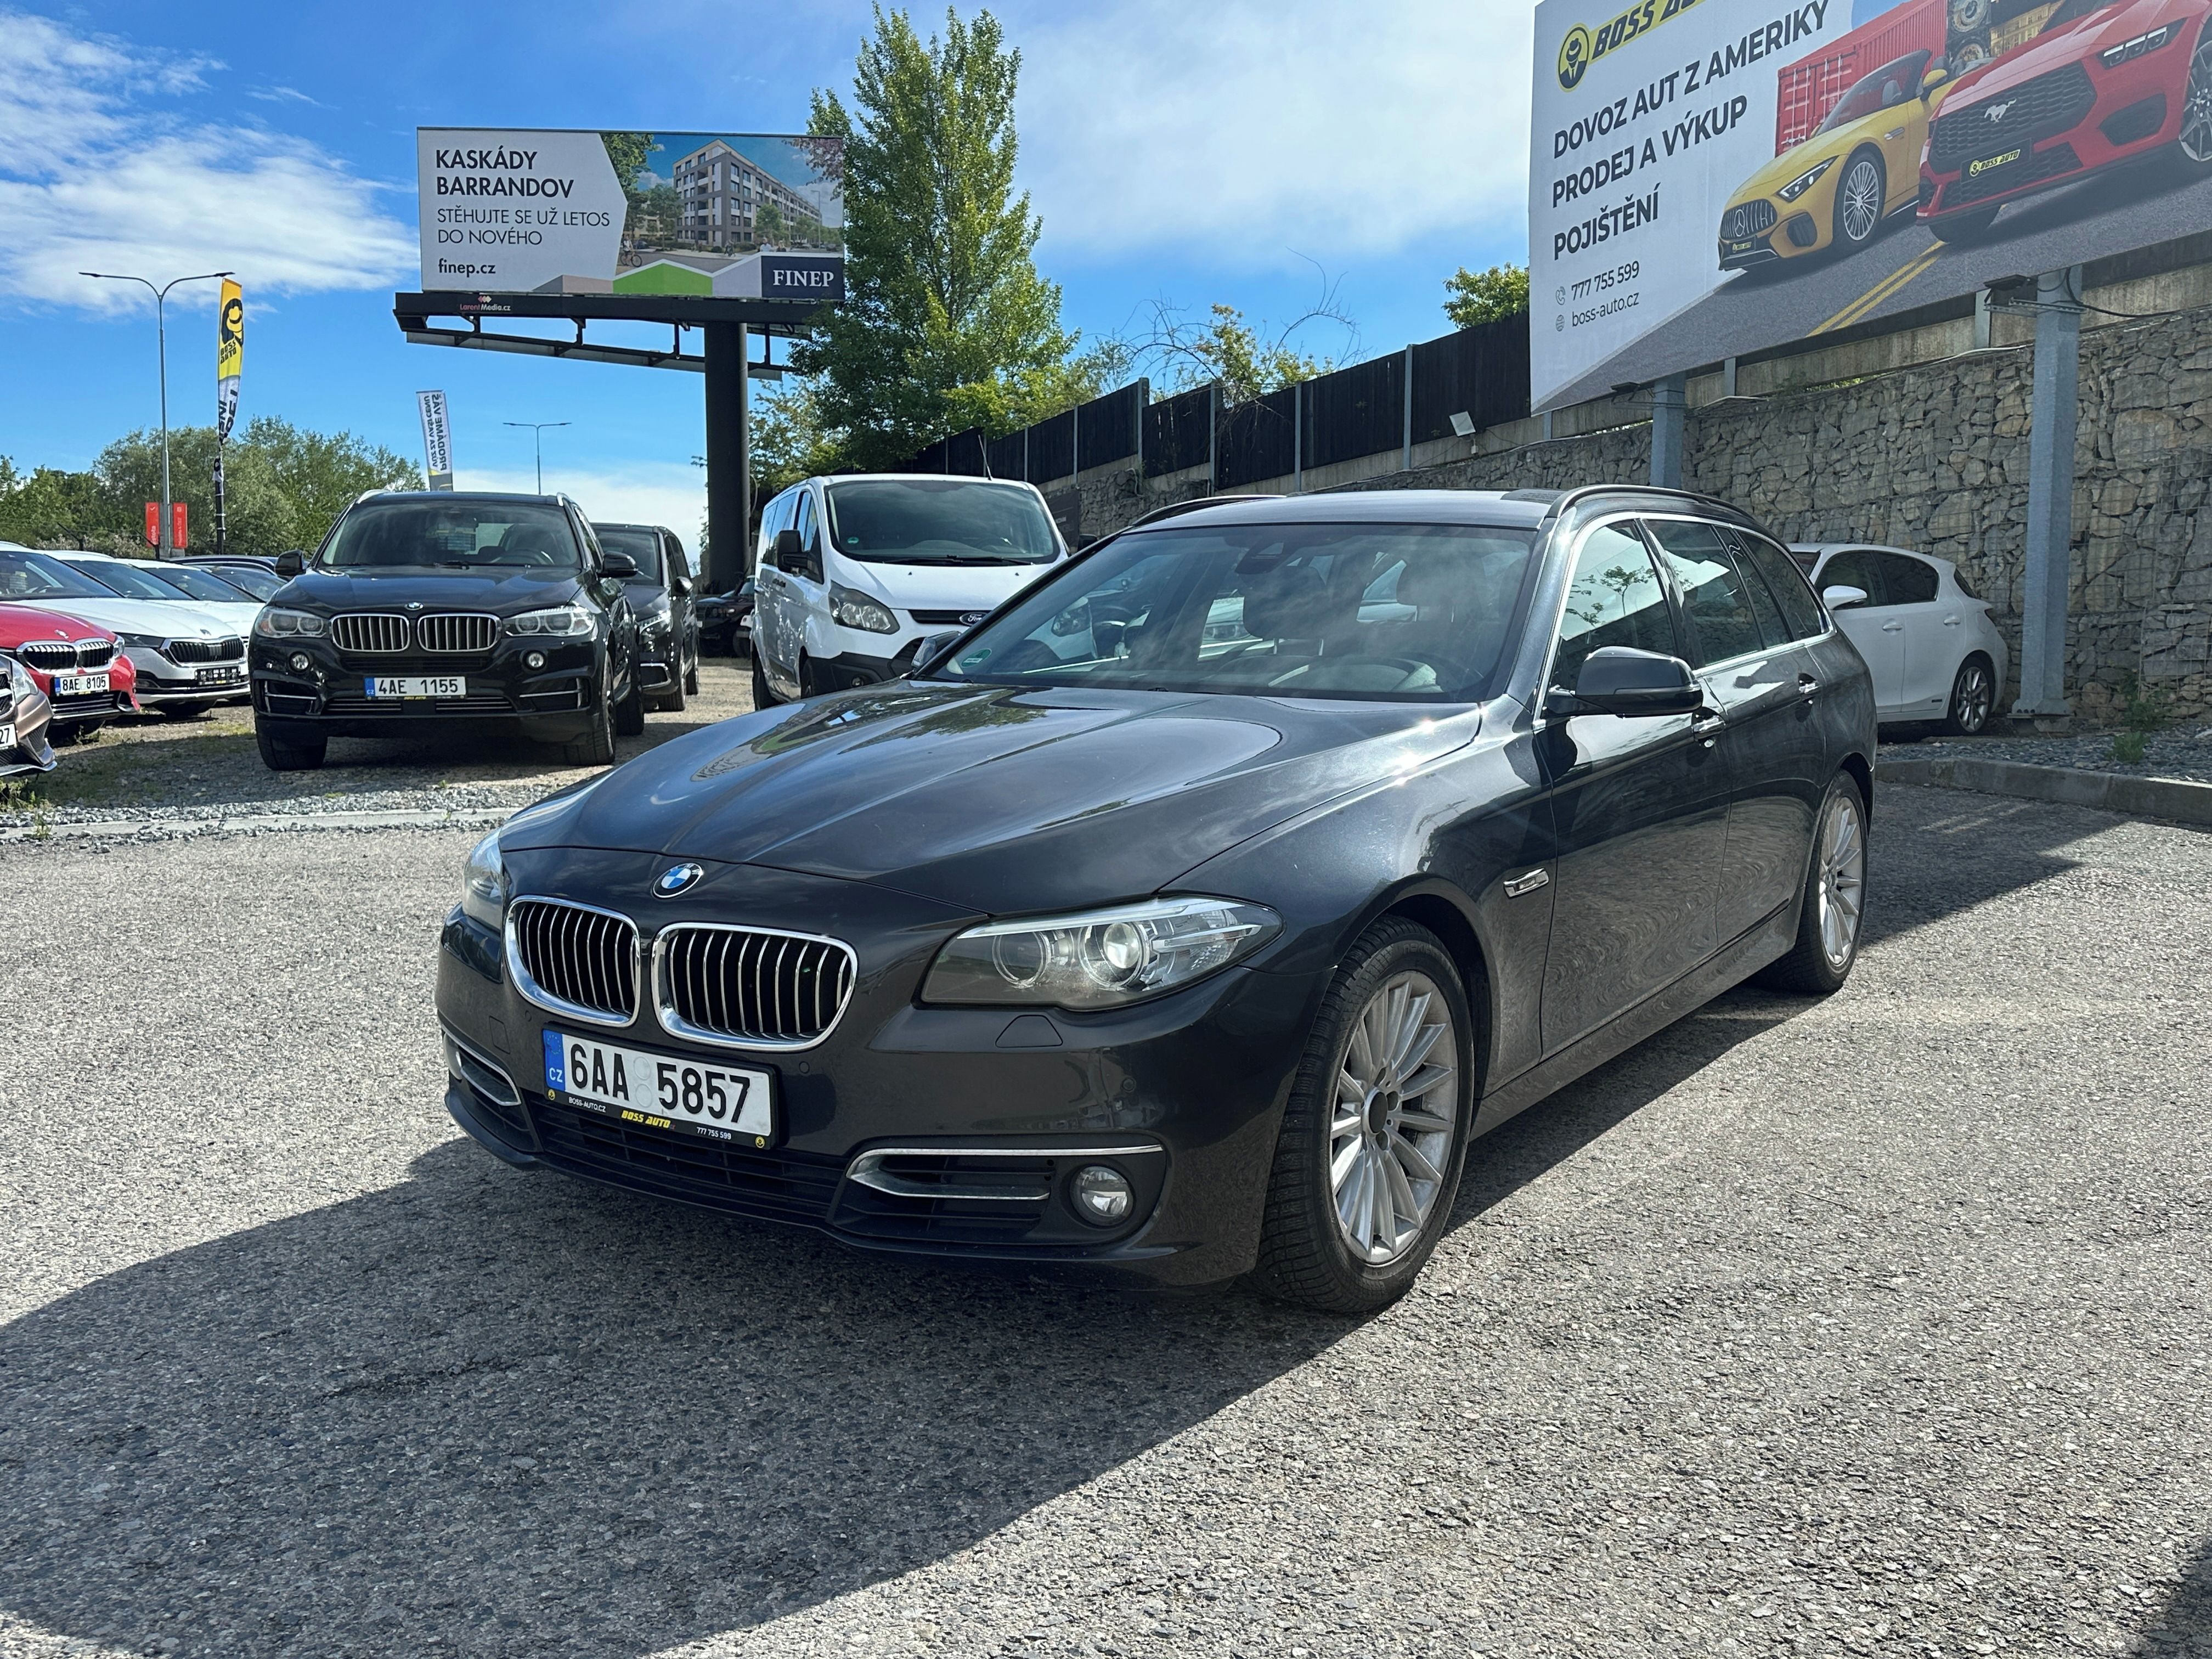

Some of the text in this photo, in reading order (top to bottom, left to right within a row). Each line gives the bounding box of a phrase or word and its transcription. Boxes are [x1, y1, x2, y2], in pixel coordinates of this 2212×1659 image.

[1592, 0, 1655, 60] BOSS
[1554, 0, 1829, 159] DOVOZ AUT Z AMERIKY
[436, 145, 538, 170] KASKÁDY
[1553, 95, 1747, 208] PRODEJ A VÝKUP
[1980, 151, 2019, 170] BOSS AUTO
[437, 176, 574, 198] BARRANDOV
[437, 205, 610, 227] STĚHUJTE SE UŽ LETOS
[1554, 182, 1661, 261] POJIŠTĚNÍ
[438, 227, 543, 245] DO NOVÉHO
[438, 258, 496, 278] finep.cz
[773, 270, 834, 287] FINEP
[1571, 261, 1639, 301] 777 755 599
[1572, 292, 1639, 327] boss-auto.cz
[220, 347, 236, 364] AUTO
[221, 340, 236, 356] BOSS
[967, 613, 983, 622] For
[63, 679, 80, 691] 8AE
[87, 676, 106, 689] 8105
[379, 679, 458, 695] 4AE 1155
[549, 1067, 563, 1083] CZ
[571, 1043, 751, 1123] 6AA 5857
[568, 1097, 606, 1113] BOSS-AUTO.CZ
[621, 1110, 644, 1122] BOSS
[645, 1116, 671, 1128] AUTO
[696, 1126, 707, 1135] 777
[720, 1131, 731, 1140] 599
